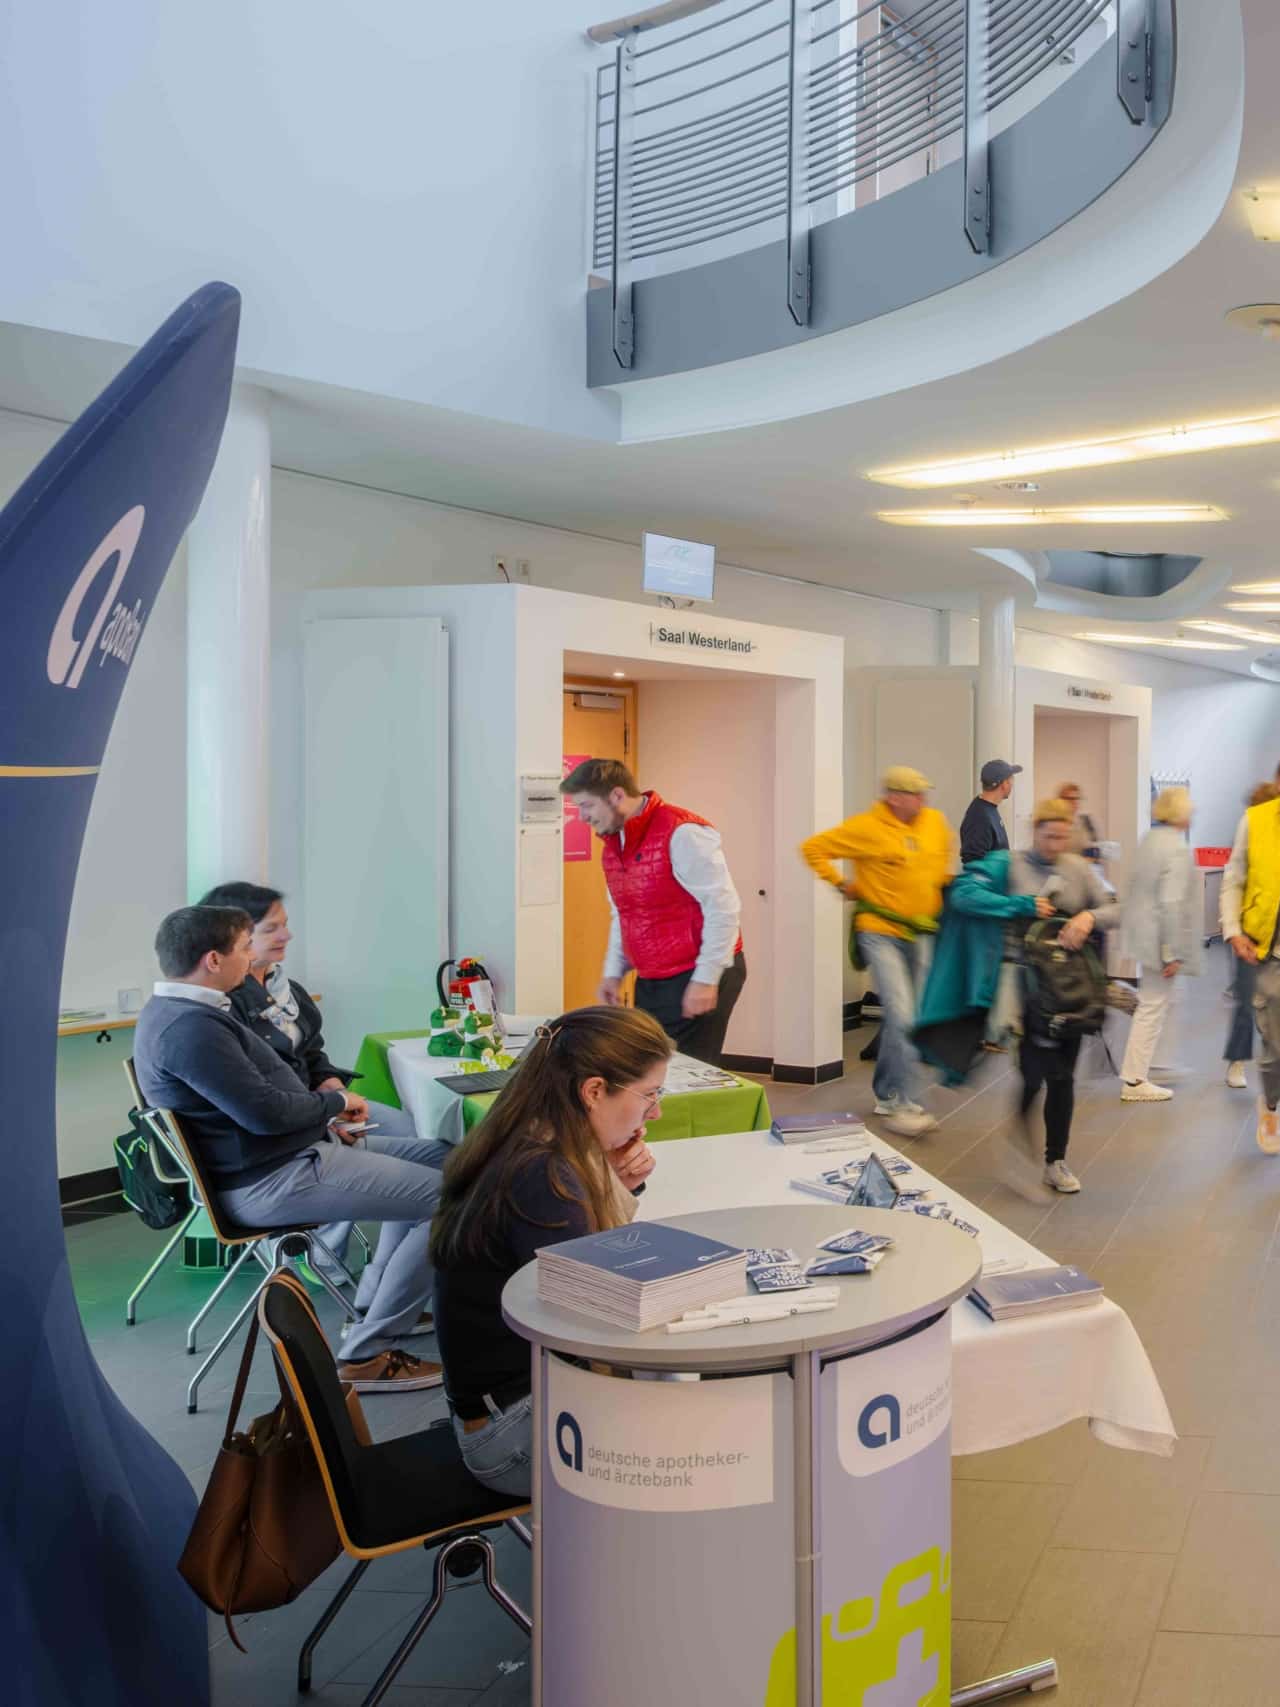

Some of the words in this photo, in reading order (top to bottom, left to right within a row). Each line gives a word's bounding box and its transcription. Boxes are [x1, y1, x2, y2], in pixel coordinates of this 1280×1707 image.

[658, 627, 685, 645] Saal
[688, 631, 752, 654] Westerland
[588, 1445, 651, 1467] deutsche
[655, 1451, 750, 1471] apotheker-
[588, 1465, 610, 1481] und
[615, 1467, 695, 1488] ärztebank
